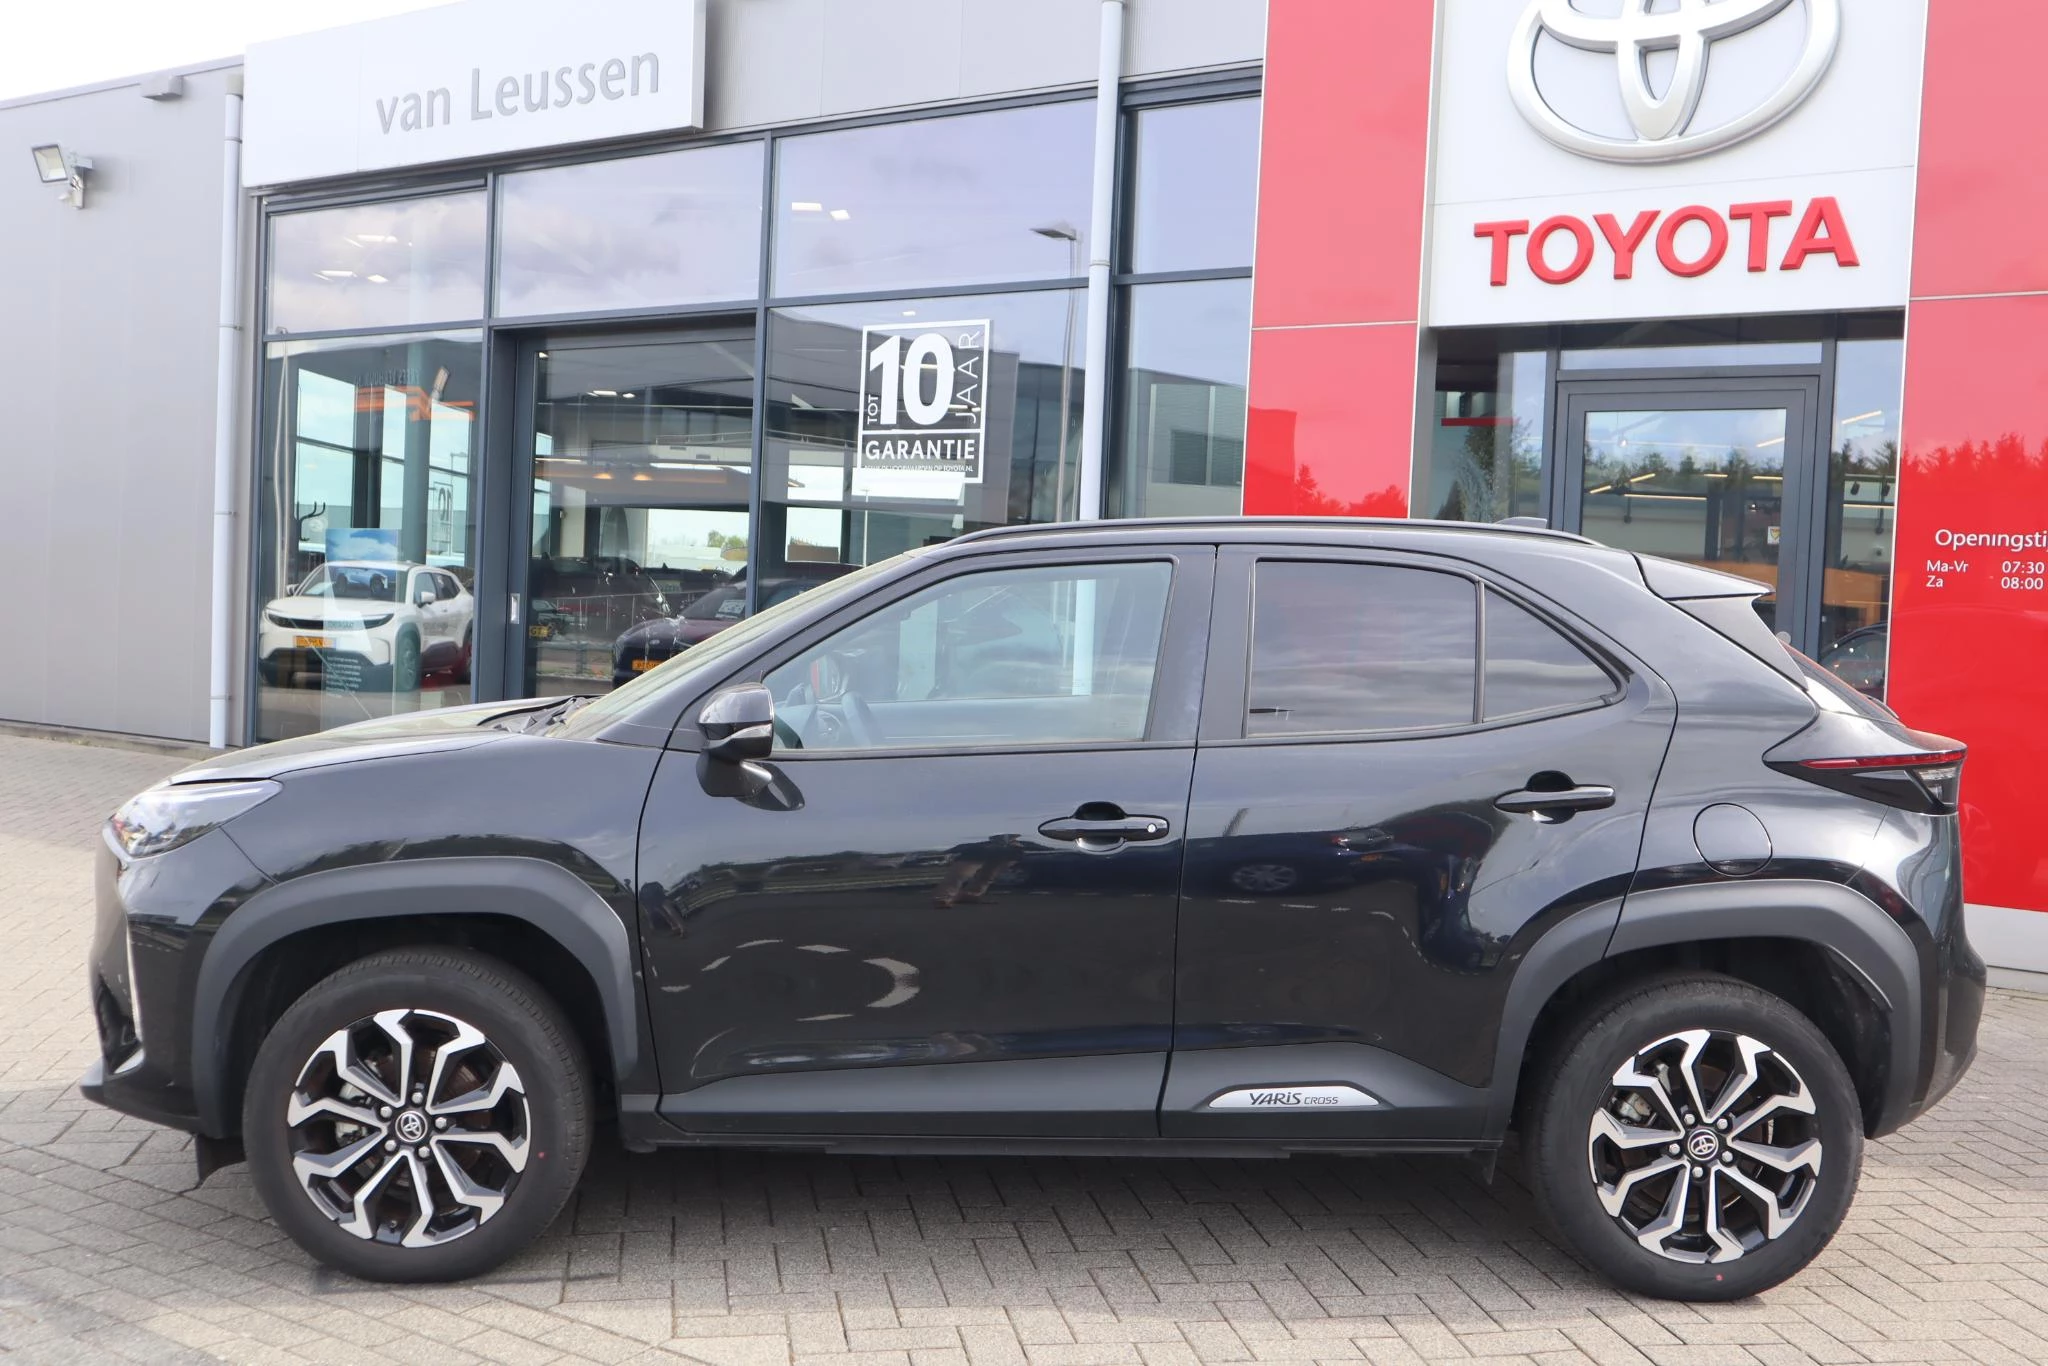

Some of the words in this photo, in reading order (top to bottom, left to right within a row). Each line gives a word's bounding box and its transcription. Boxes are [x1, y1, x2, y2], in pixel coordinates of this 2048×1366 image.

[376, 86, 450, 134] van
[471, 52, 659, 121] Leussen
[1474, 196, 1860, 287] TOYOTA
[869, 332, 955, 426] 10
[955, 331, 980, 424] JAAR
[867, 394, 879, 425] TOT
[865, 439, 975, 460] GARANTIE
[1935, 529, 2048, 552] Openingsti
[1926, 560, 1968, 573] Ma-Vr
[2002, 561, 2045, 574] 07:30
[1926, 575, 1944, 588] Za
[2001, 577, 2044, 590] 08:00
[1304, 1096, 1338, 1105] CROSS
